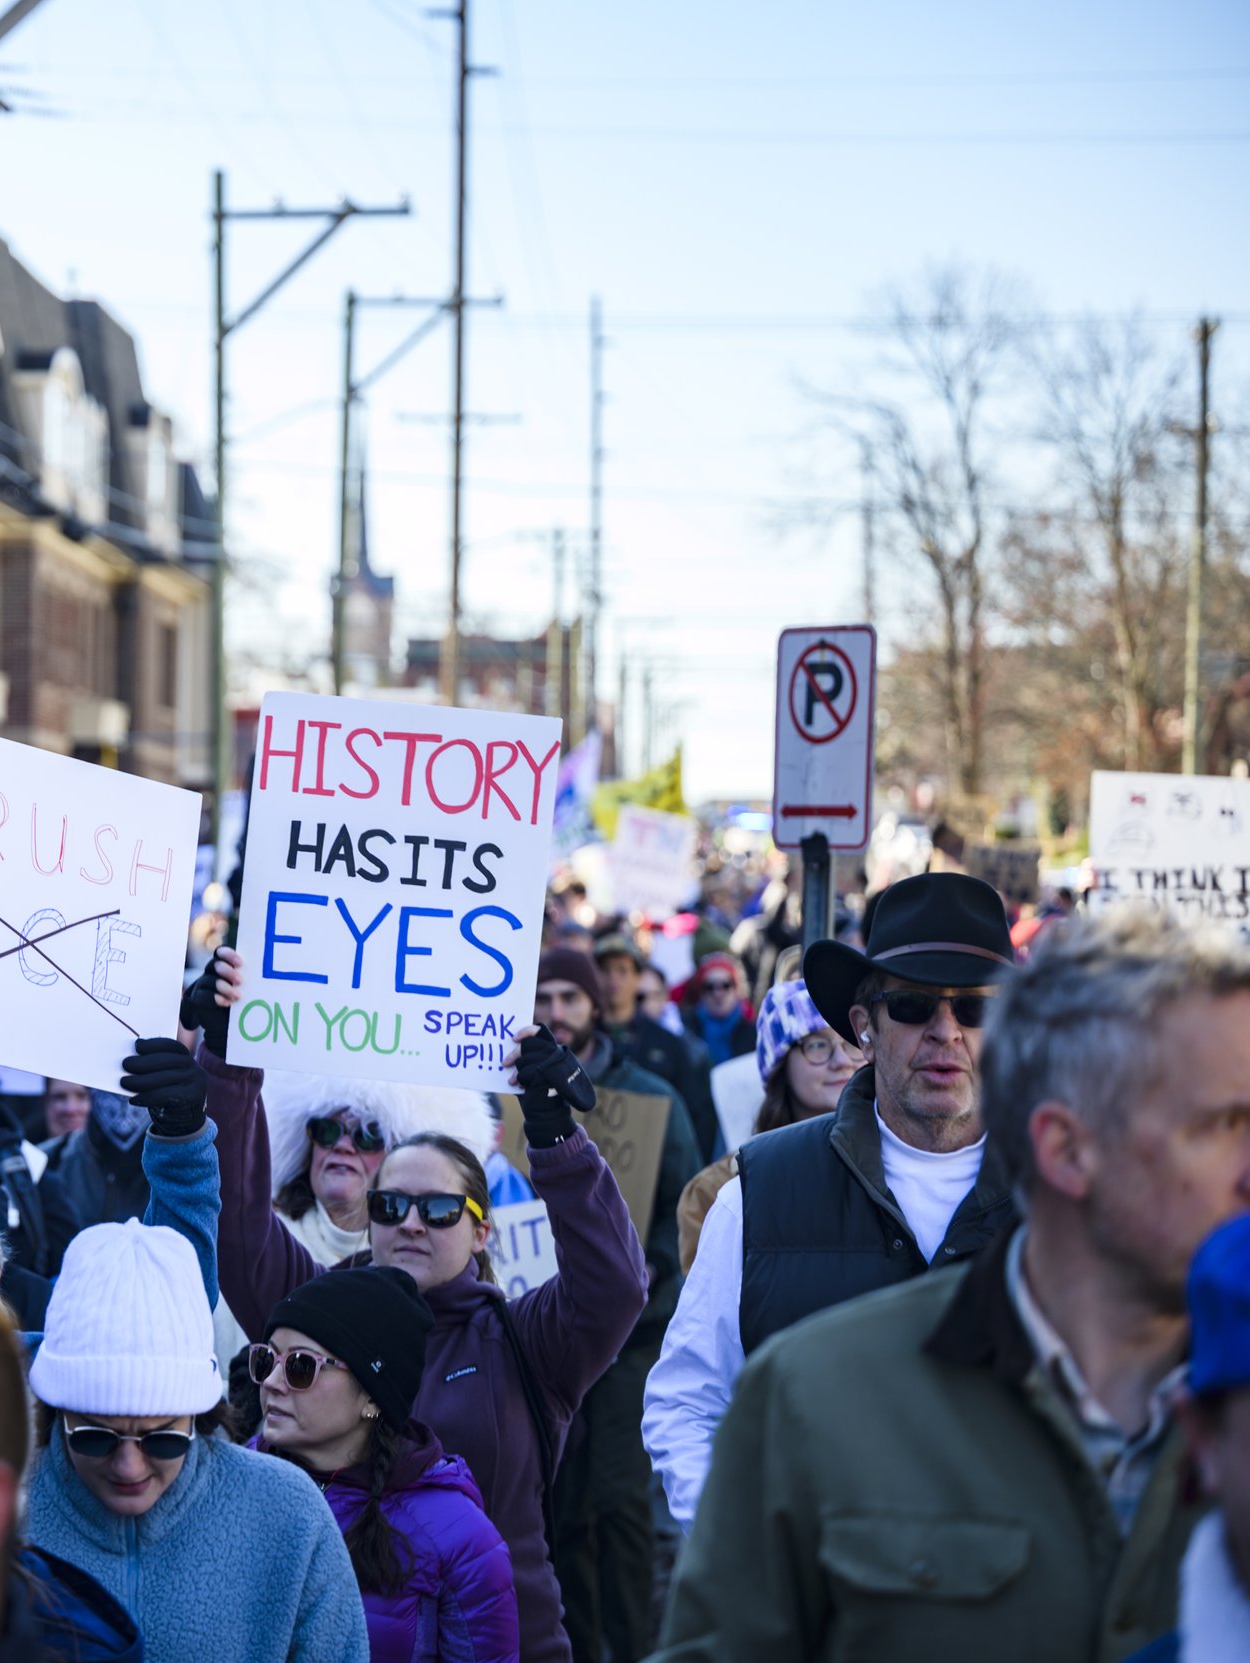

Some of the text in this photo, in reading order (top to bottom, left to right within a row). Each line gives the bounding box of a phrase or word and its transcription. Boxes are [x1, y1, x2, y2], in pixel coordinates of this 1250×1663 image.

[259, 715, 562, 825] HISTORY
[1129, 865, 1224, 892] THINK
[262, 890, 524, 998] EYES
[238, 999, 422, 1057] ON YOU...
[423, 1009, 516, 1039] SPEAK
[445, 1044, 505, 1072] UP!!!
